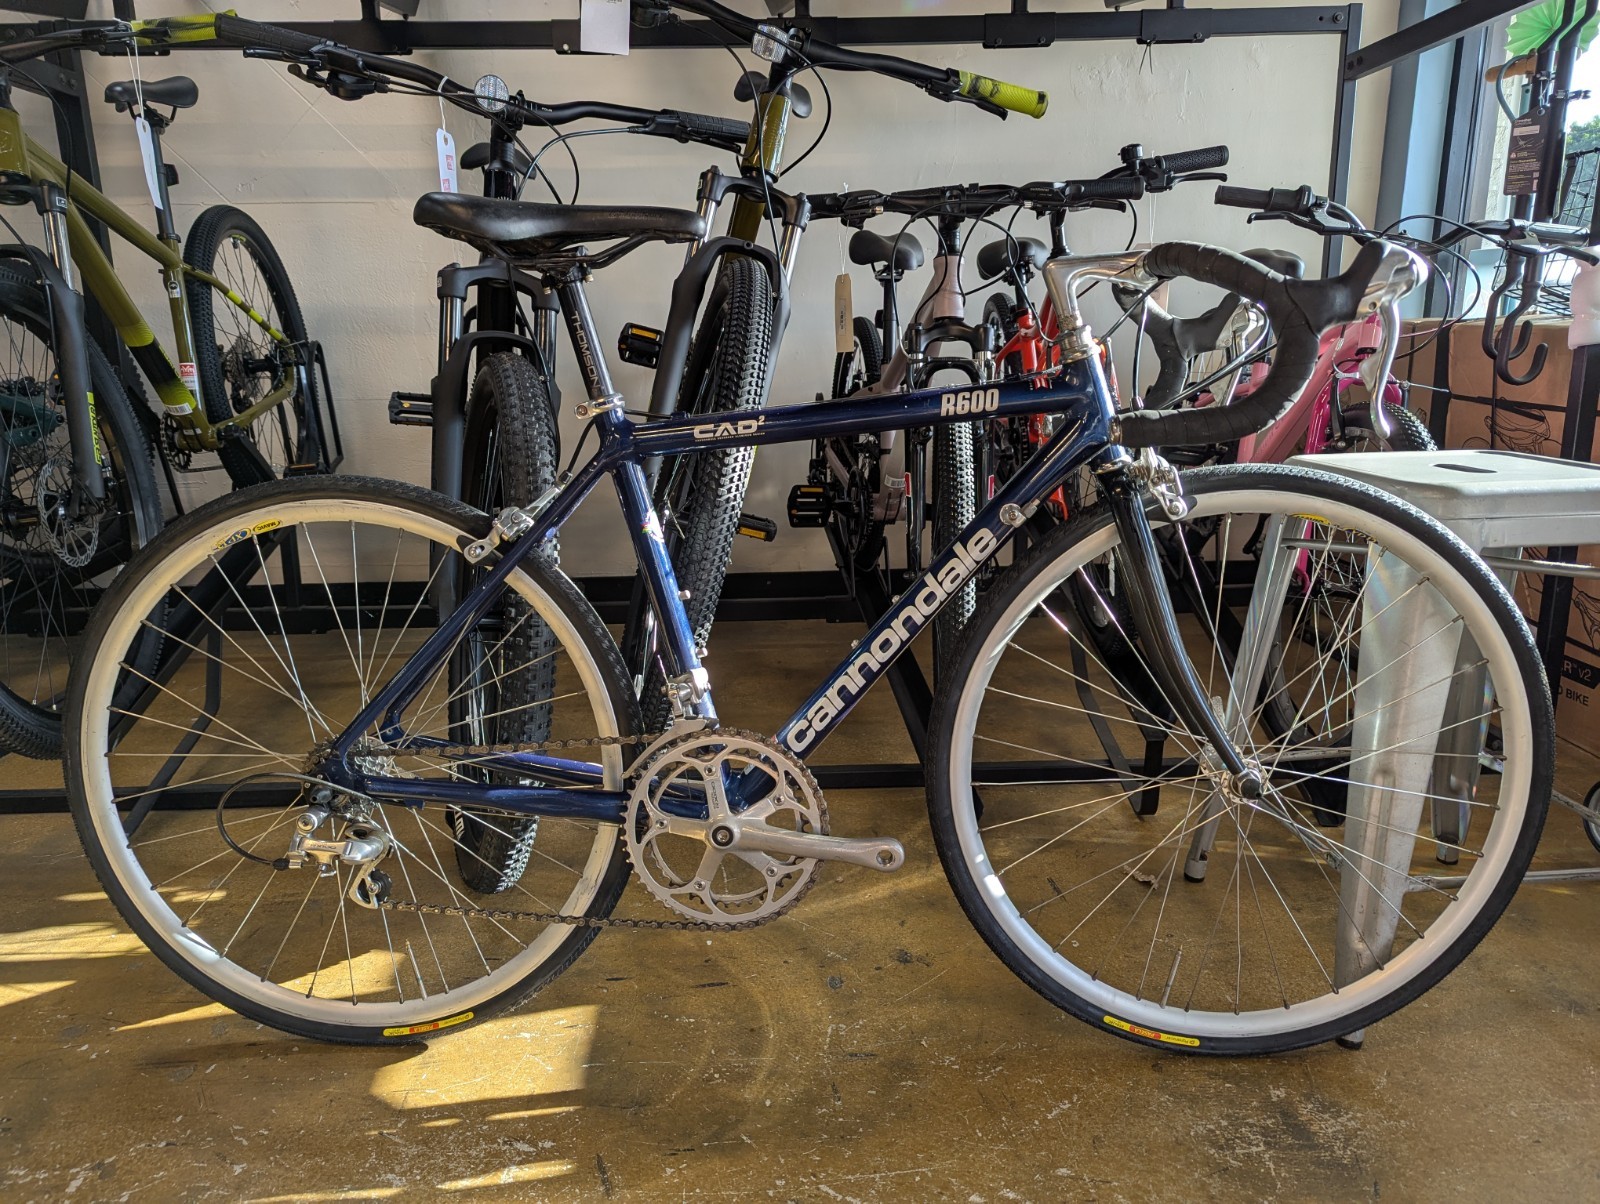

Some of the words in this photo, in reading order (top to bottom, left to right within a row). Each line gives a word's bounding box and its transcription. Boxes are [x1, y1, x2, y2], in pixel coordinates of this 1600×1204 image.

[571, 310, 601, 388] THOMSON
[940, 388, 1000, 417] R600
[786, 527, 998, 753] cannondale
[1565, 688, 1589, 707] BIKE
